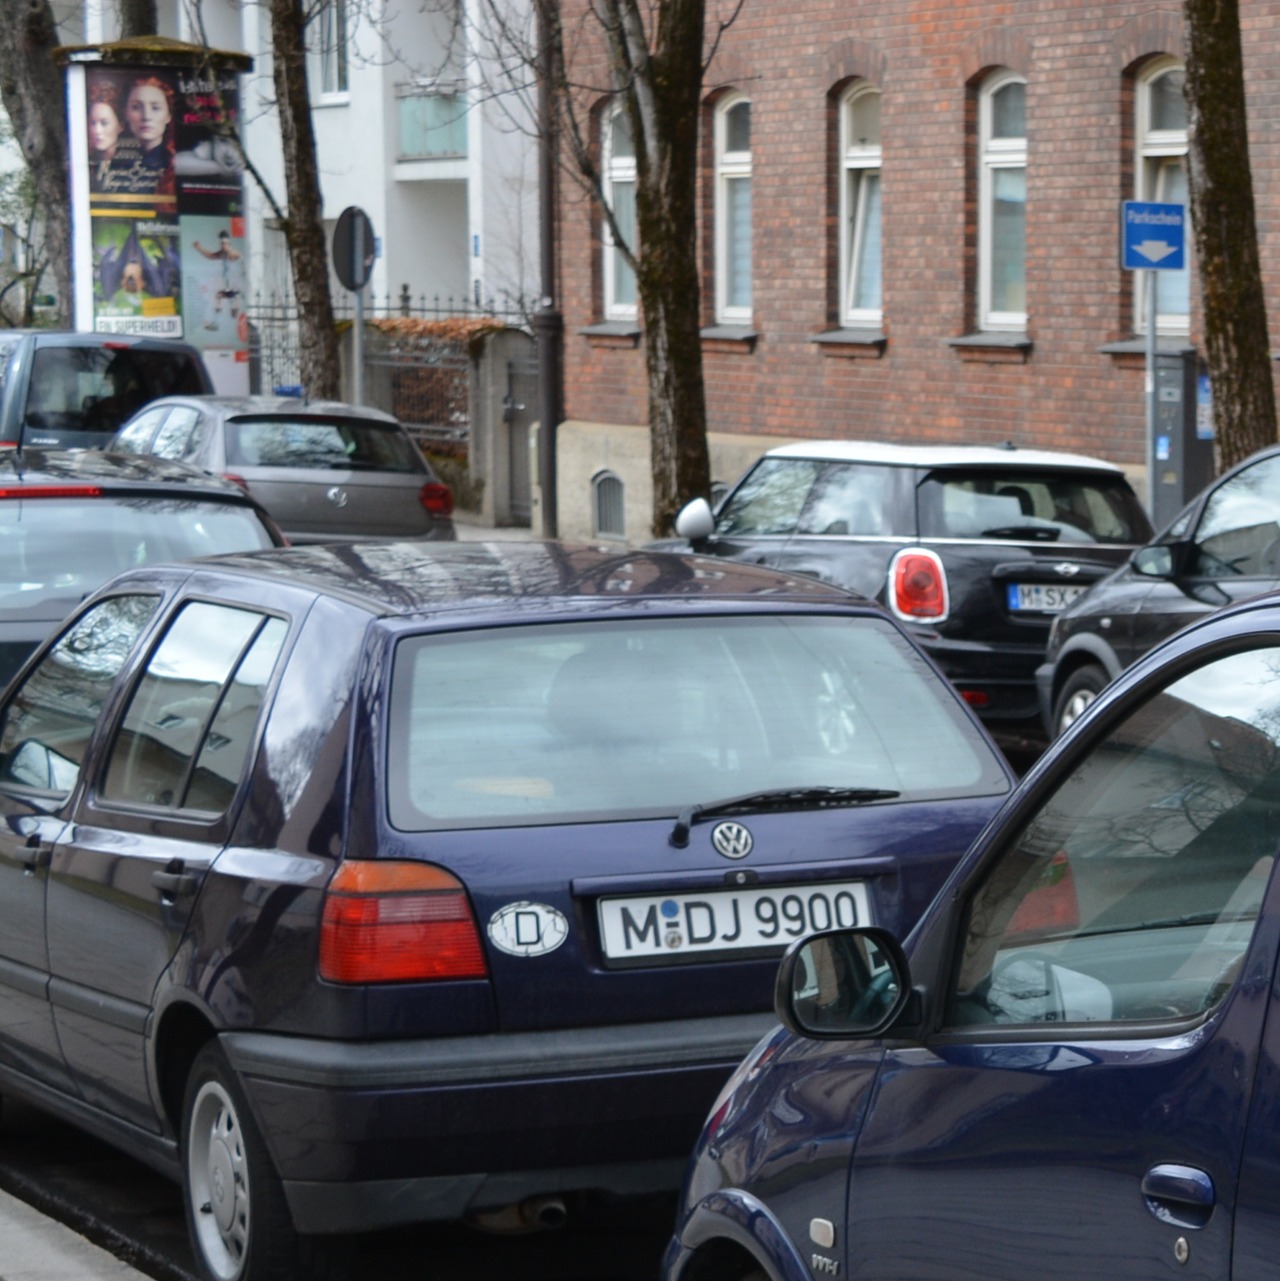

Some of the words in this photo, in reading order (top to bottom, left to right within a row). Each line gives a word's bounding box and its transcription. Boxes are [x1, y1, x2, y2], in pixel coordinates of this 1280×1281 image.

[1127, 210, 1182, 226] Parkschein
[1021, 586, 1033, 605] M
[515, 911, 541, 945] D
[755, 891, 859, 939] 9900
